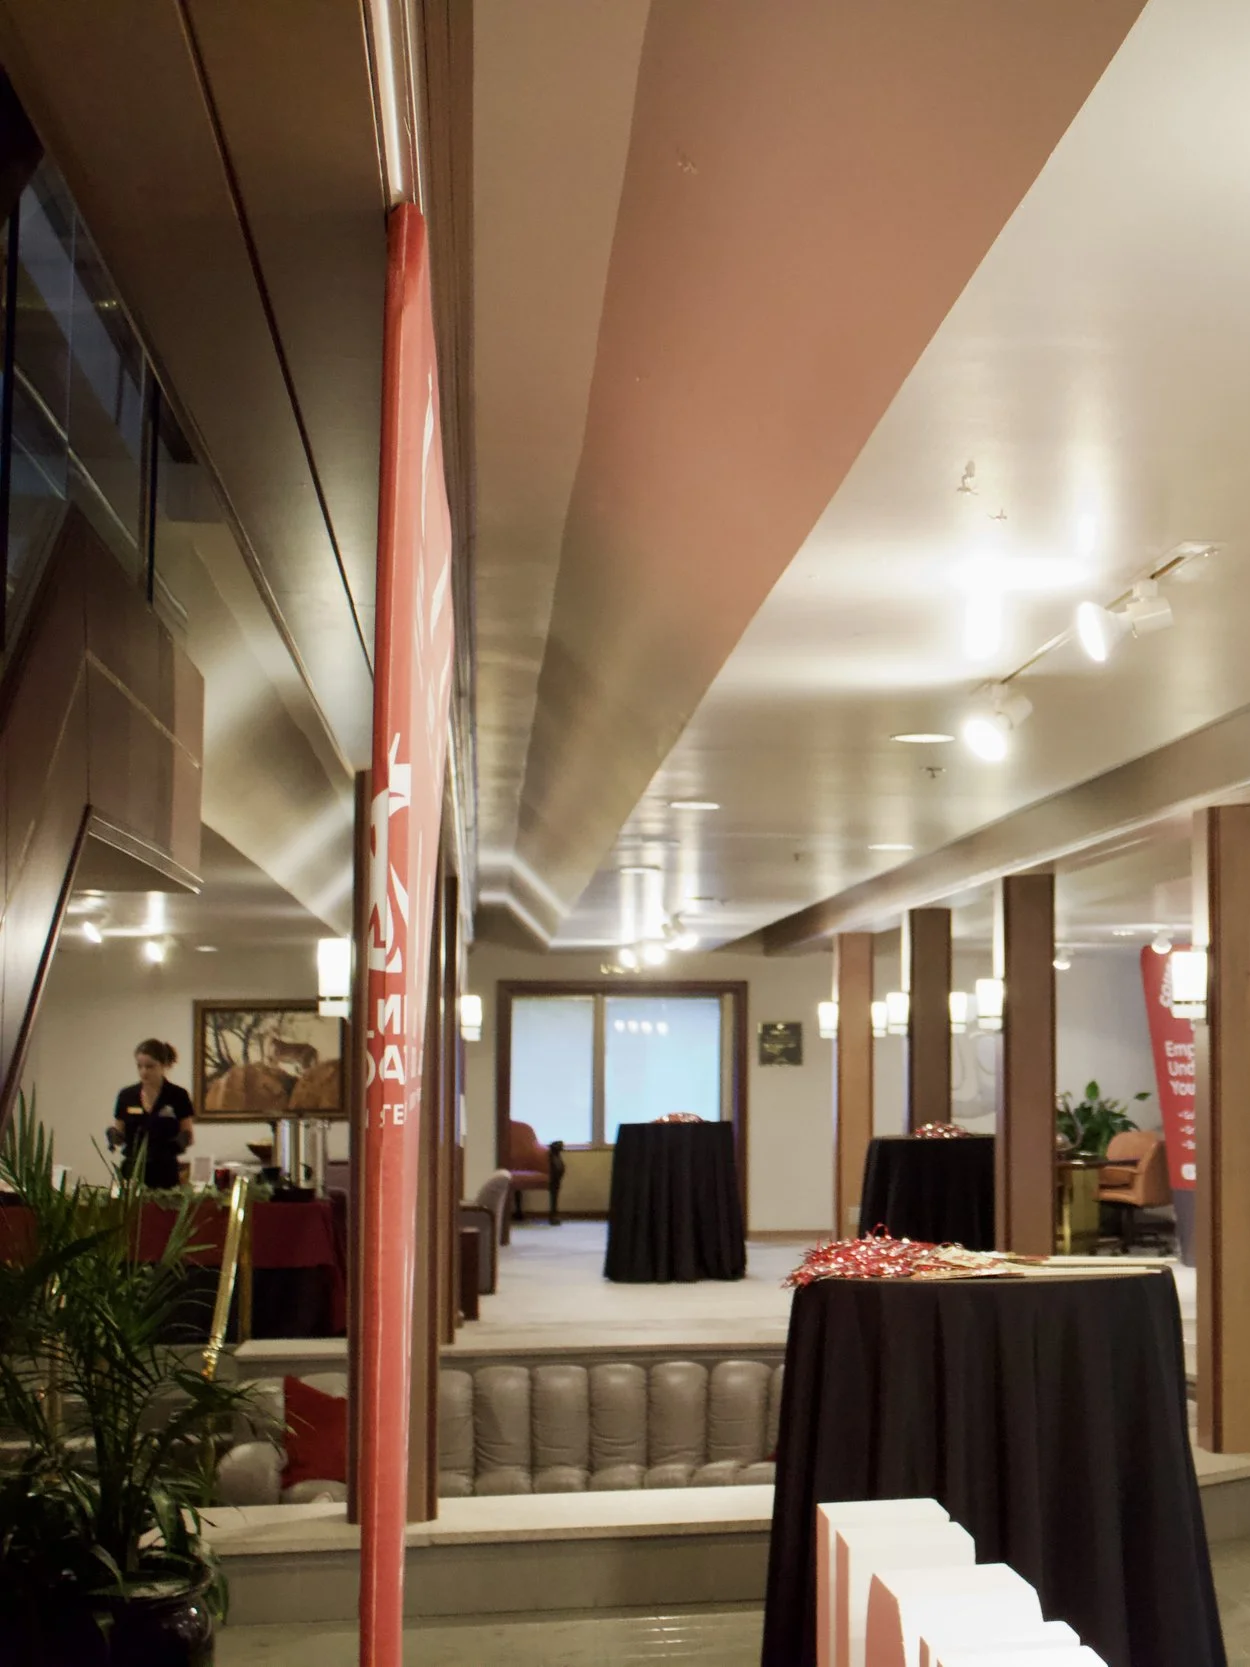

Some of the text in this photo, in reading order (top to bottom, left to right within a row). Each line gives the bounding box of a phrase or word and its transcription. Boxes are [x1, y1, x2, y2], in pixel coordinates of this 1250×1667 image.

[1164, 1040, 1195, 1060] Emp
[1167, 1060, 1195, 1077] Und
[1169, 1080, 1196, 1096] You
